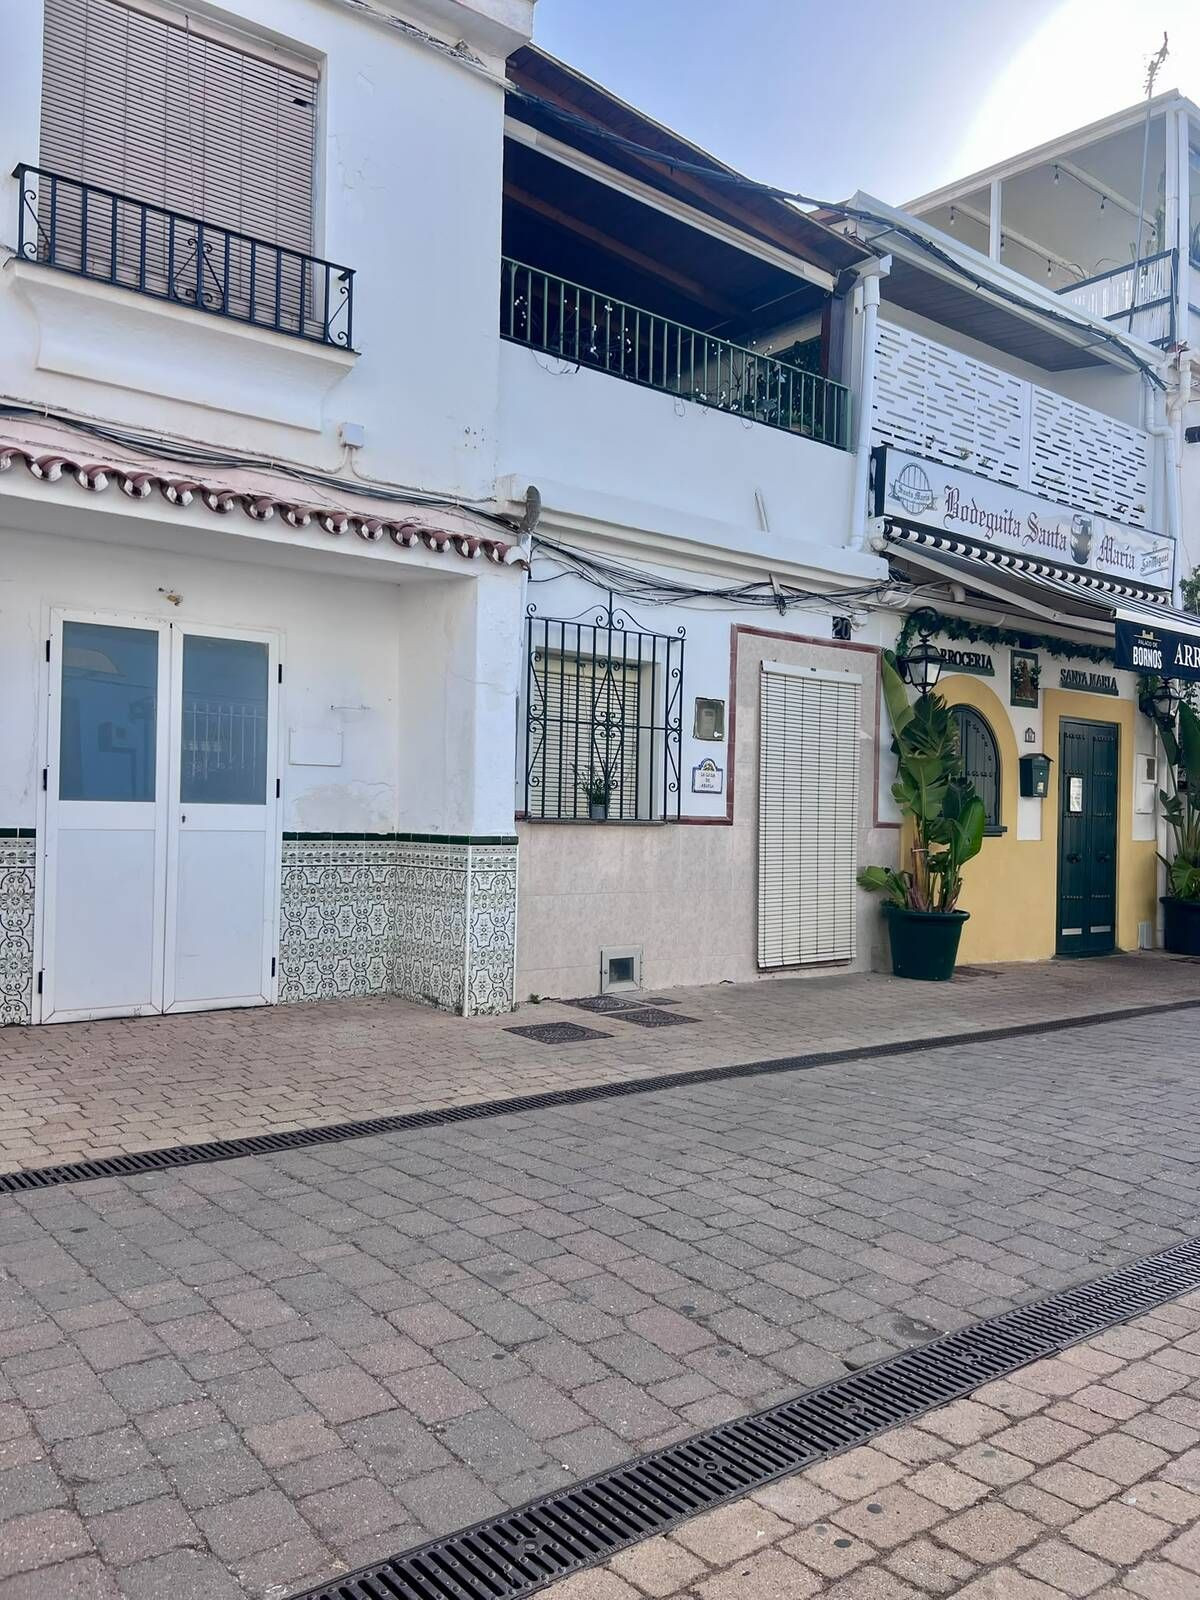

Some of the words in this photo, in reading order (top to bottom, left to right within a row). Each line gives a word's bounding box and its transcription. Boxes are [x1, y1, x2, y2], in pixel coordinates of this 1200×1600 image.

[943, 485, 1021, 540] Bodeguita
[1022, 511, 1067, 552] Santa
[1132, 645, 1163, 670] BORNOS
[1060, 667, 1089, 687] SANTA
[1089, 672, 1118, 690] MARIA
